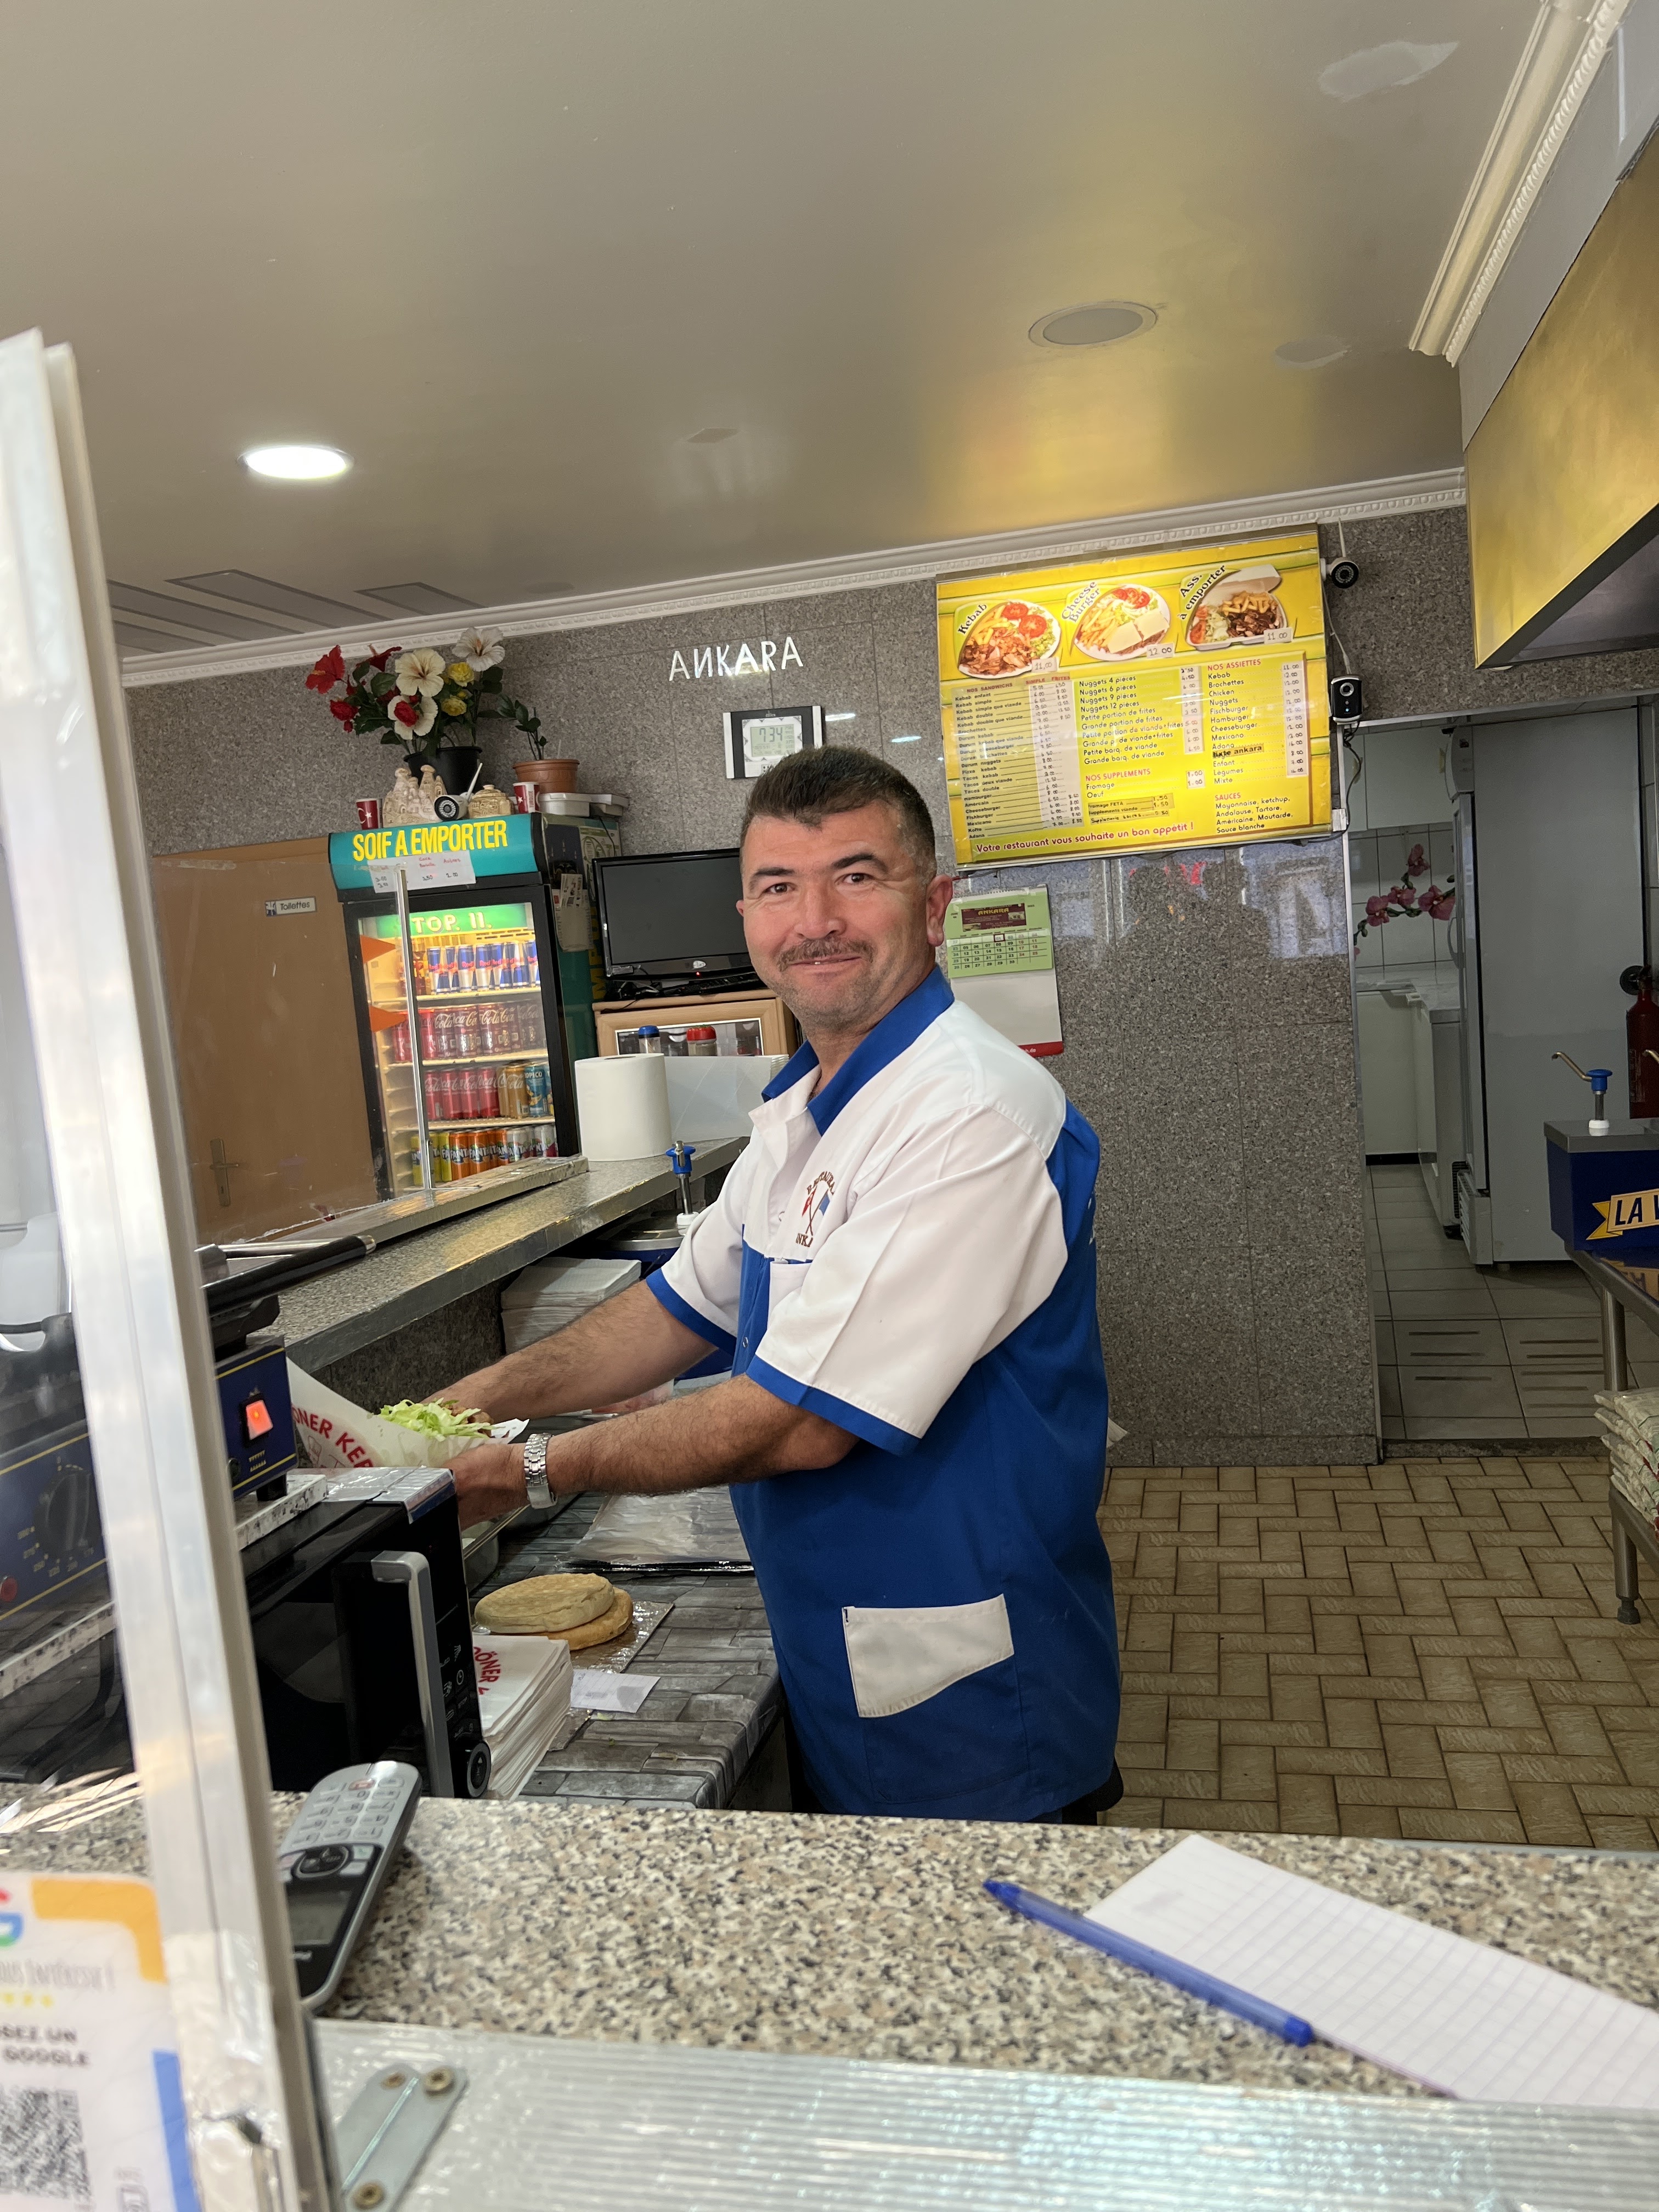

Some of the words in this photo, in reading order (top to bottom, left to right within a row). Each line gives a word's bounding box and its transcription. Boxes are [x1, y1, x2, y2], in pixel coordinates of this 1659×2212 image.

[1181, 574, 1203, 597] Ass.
[1185, 565, 1226, 611] emporter
[1062, 581, 1097, 620] Cheese
[1069, 588, 1101, 623] Burger
[957, 603, 988, 635] Kebab
[1226, 659, 1261, 669] ASSIETTES
[981, 682, 1013, 691] SANDWICHS
[1079, 679, 1107, 687] Nuggets
[1080, 687, 1107, 696] Nuggets
[1080, 696, 1107, 704] Nuggets
[1210, 698, 1238, 707] Nuggets
[1081, 705, 1108, 713] Nuggets
[1210, 706, 1248, 714] Fischburger
[1109, 719, 1133, 727] portion
[1211, 715, 1249, 723] Hamburger
[1211, 723, 1257, 732] Cheeseburger
[1212, 733, 1244, 741] Mexicano
[1234, 746, 1262, 755] ankara
[1103, 769, 1150, 780] SUPPLEMENTS
[1215, 792, 1241, 801] SAUCES
[1217, 825, 1236, 833] Sauce
[353, 831, 392, 861] SOIF
[396, 830, 408, 857] A
[411, 820, 507, 855] EMPORTER
[977, 844, 1000, 852] Votre
[1003, 838, 1049, 850] restaurant
[1075, 832, 1114, 842] souhaite
[280, 901, 309, 910] Toilettes
[1615, 1198, 1643, 1226] LA
